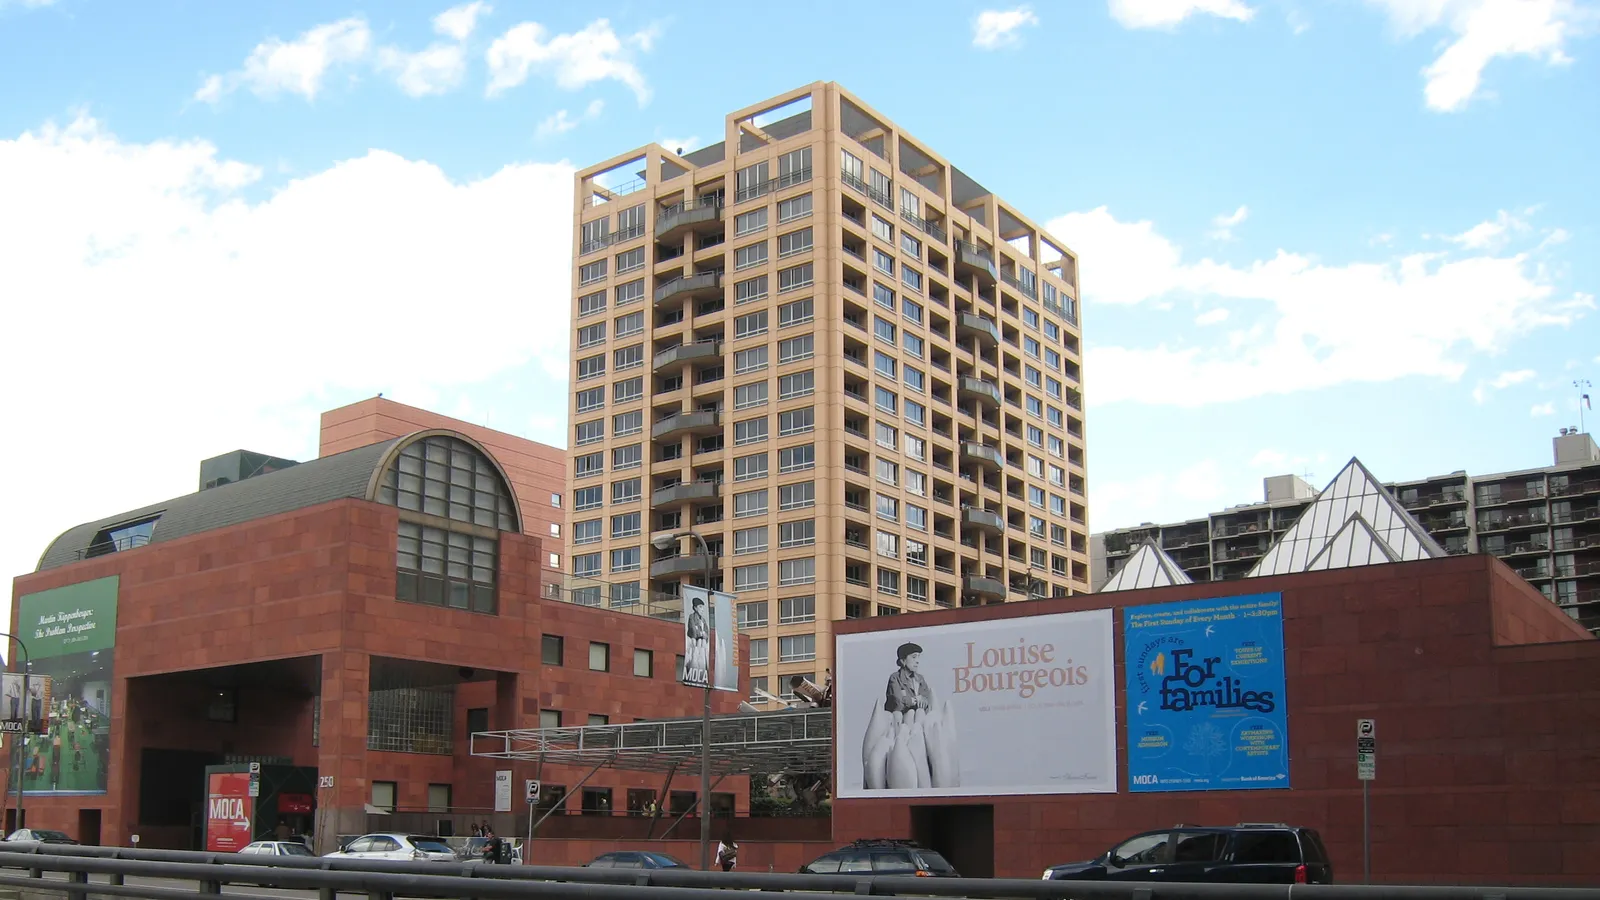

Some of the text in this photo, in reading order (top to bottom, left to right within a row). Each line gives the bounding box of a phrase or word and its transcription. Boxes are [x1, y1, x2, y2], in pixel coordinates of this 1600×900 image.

[1216, 604, 1229, 612] with
[1131, 620, 1143, 628] The
[1160, 616, 1184, 626] Sunday
[1193, 615, 1212, 623] Every
[1213, 612, 1236, 620] Month
[964, 637, 1055, 669] Louise
[1137, 636, 1184, 694] first sundays are
[1171, 648, 1221, 688] For
[682, 666, 708, 684] MOCA
[952, 658, 1089, 699] Bourgeois
[1159, 676, 1275, 713] families
[0, 721, 23, 731] MOCA
[319, 776, 334, 788] 250
[1133, 775, 1158, 785] MOCA
[209, 798, 244, 819] MOCA
